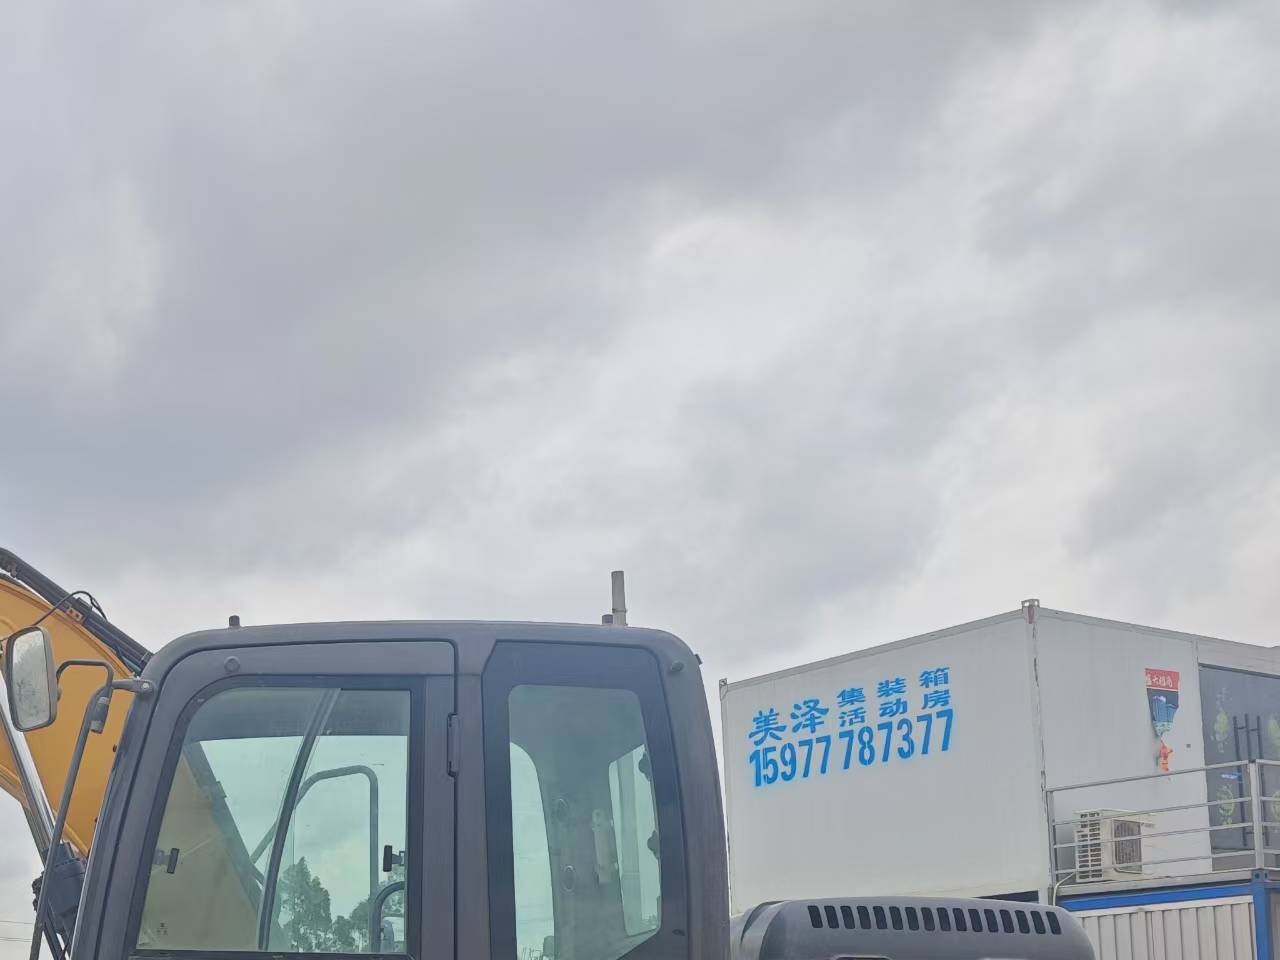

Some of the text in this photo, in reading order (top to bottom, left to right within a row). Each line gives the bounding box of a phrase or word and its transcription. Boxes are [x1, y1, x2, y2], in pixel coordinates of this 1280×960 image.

[837, 667, 950, 708] 集装箱
[839, 689, 951, 727] 活动房
[748, 699, 829, 747] 美泽
